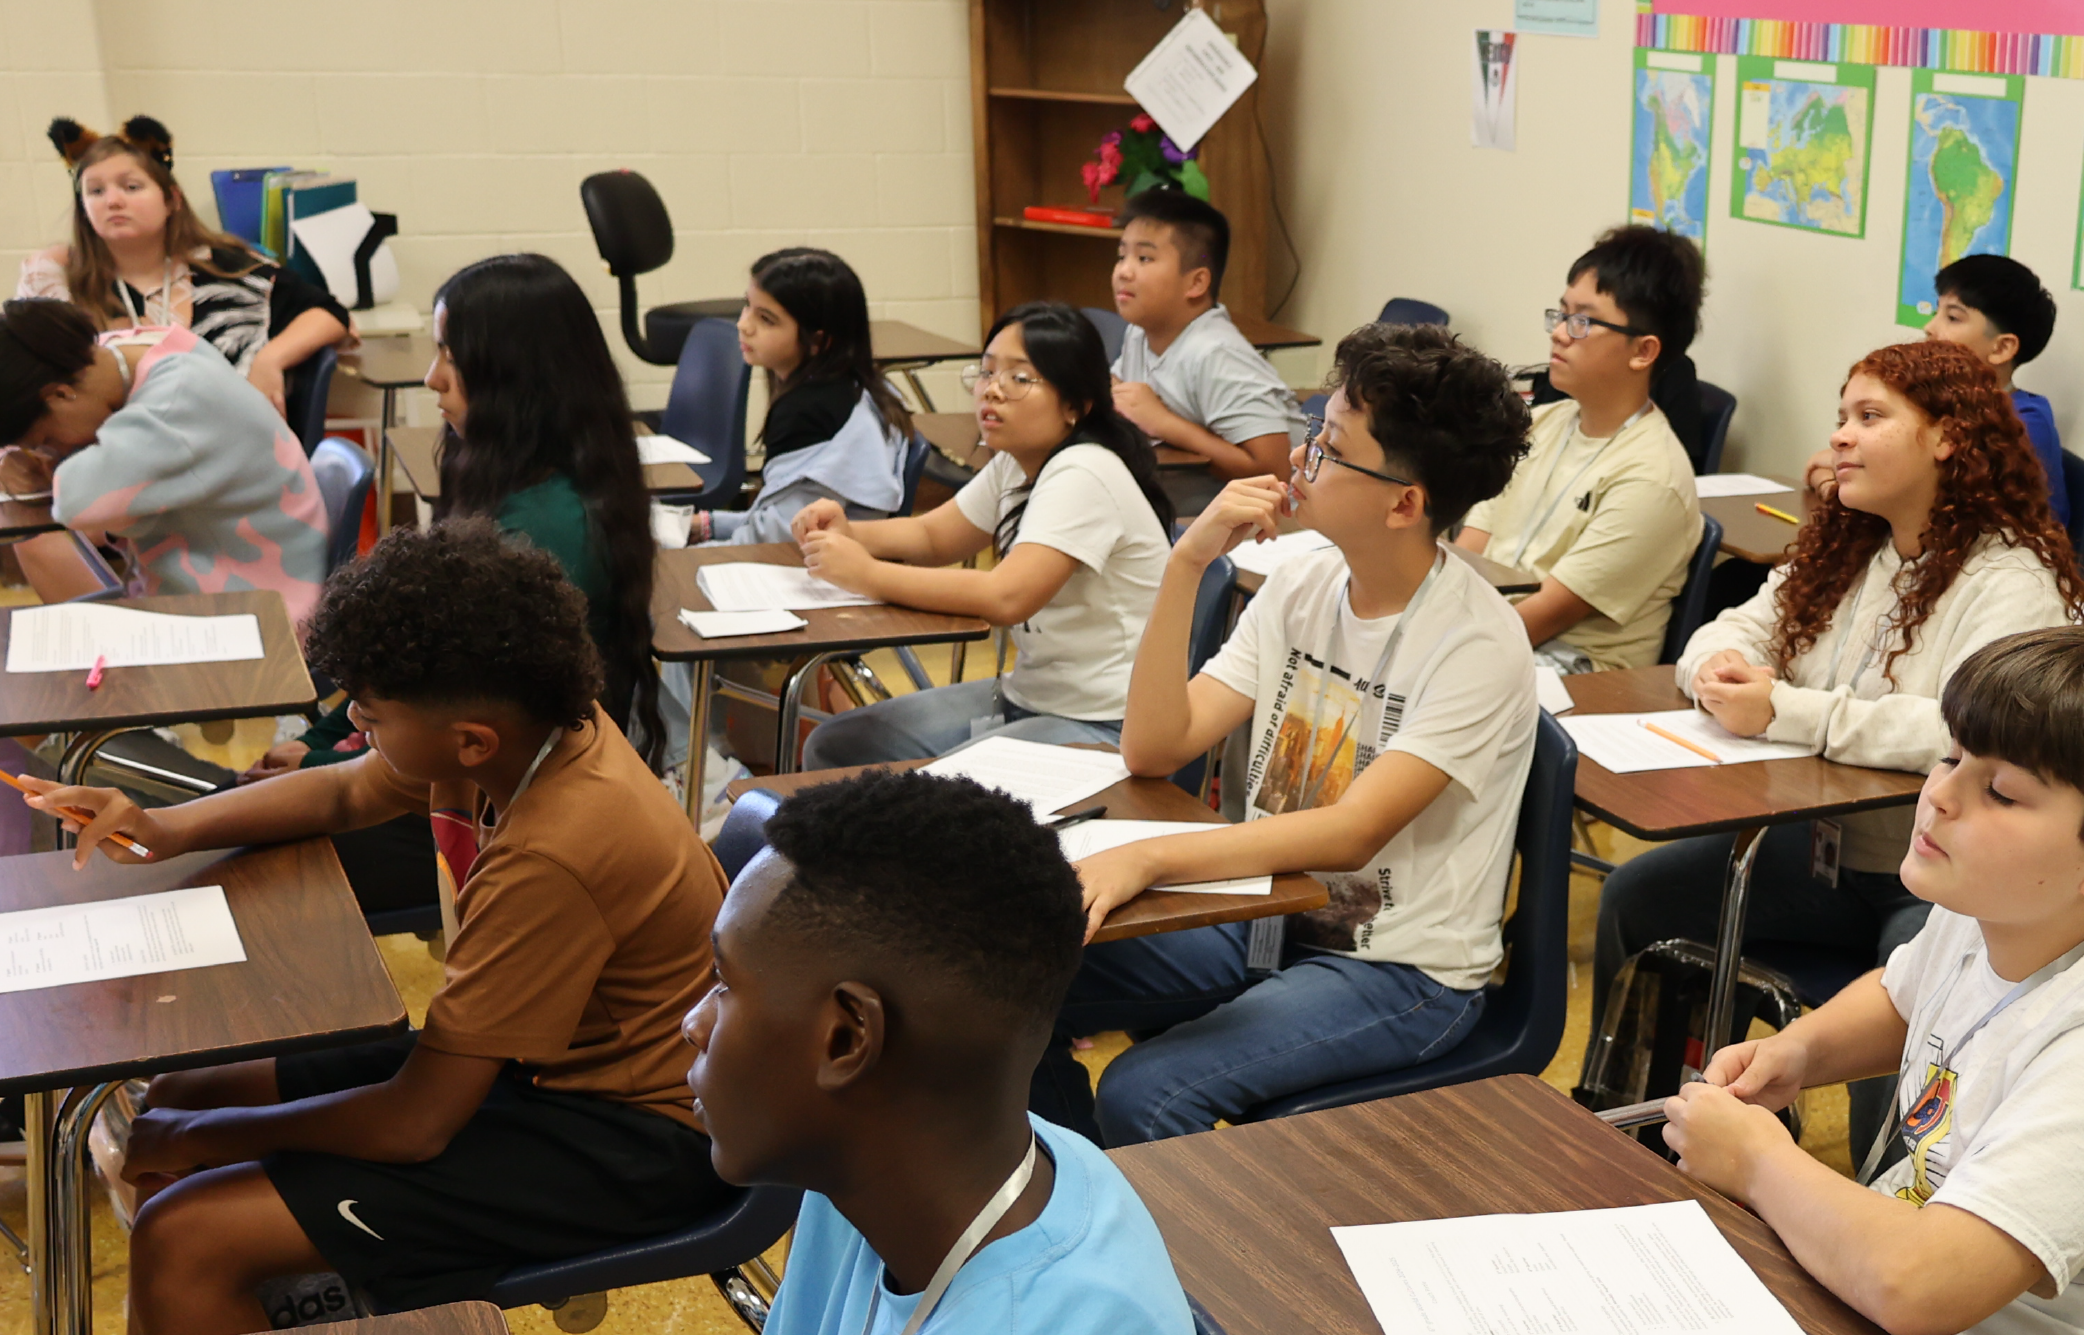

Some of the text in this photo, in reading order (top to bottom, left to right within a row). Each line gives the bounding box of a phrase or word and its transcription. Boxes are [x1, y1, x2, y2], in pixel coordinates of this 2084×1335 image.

[1285, 647, 1302, 670] Not
[1273, 672, 1293, 712] afraid
[1269, 713, 1278, 728] of
[1378, 868, 1393, 900] Strive
